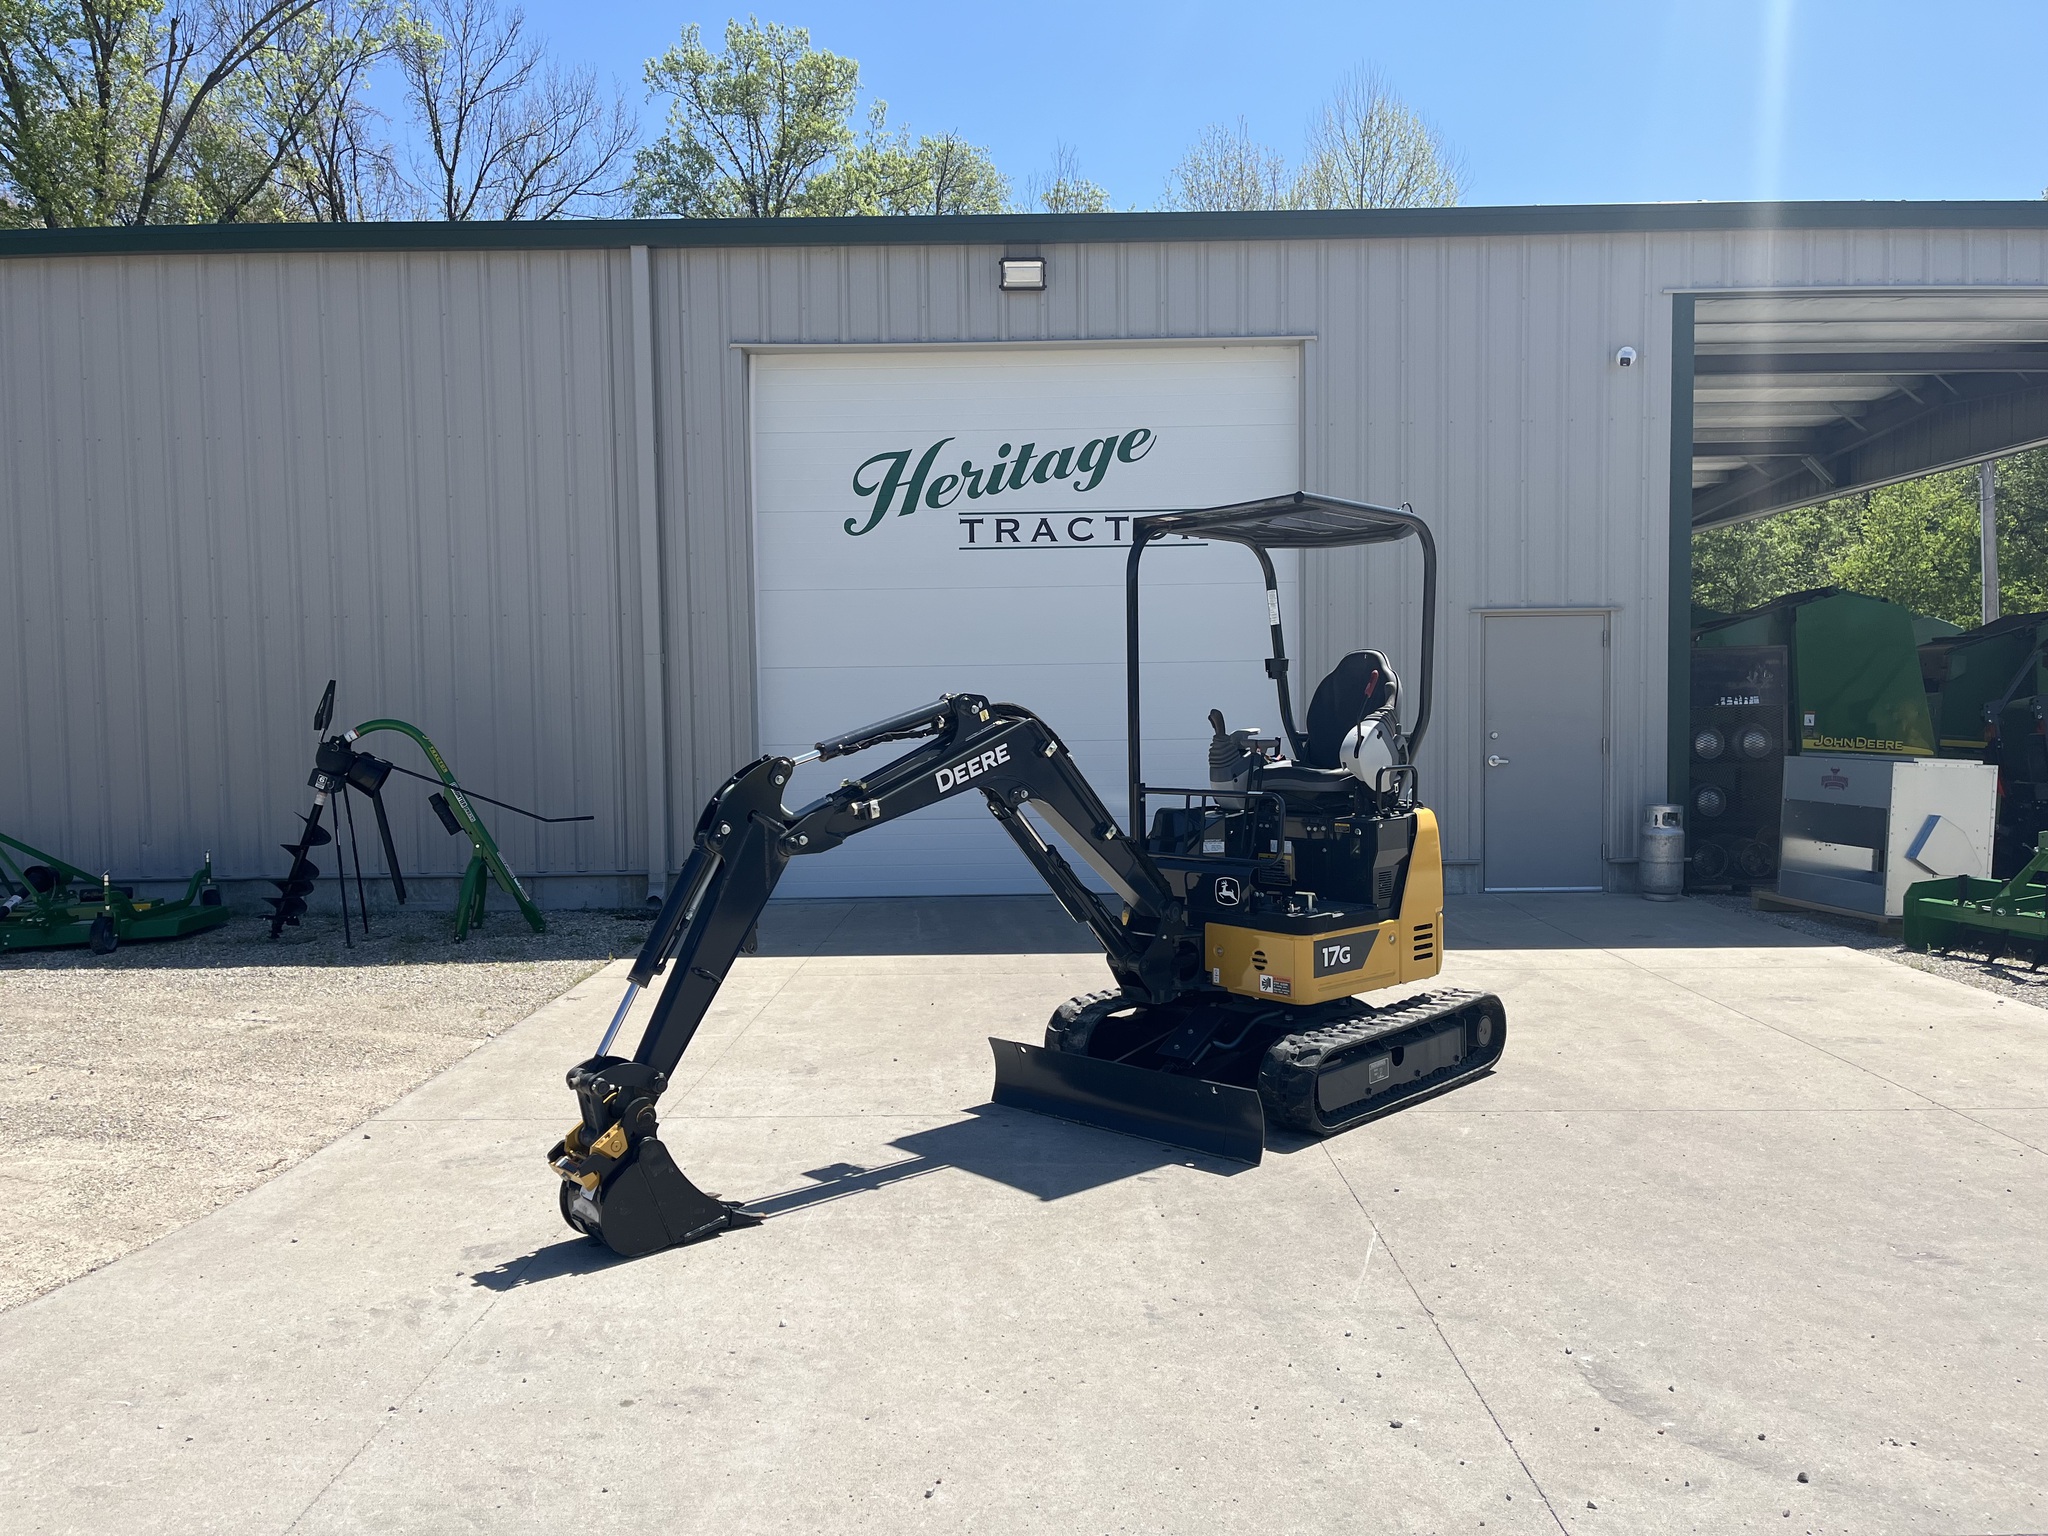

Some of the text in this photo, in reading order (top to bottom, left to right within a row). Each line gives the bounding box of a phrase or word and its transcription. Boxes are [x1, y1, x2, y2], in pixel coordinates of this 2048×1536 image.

[844, 428, 1157, 536] Heritage
[959, 515, 1204, 544] TRACT
[1855, 737, 1904, 751] DEERE
[935, 742, 1011, 794] DEERE
[1322, 945, 1351, 968] 17G
